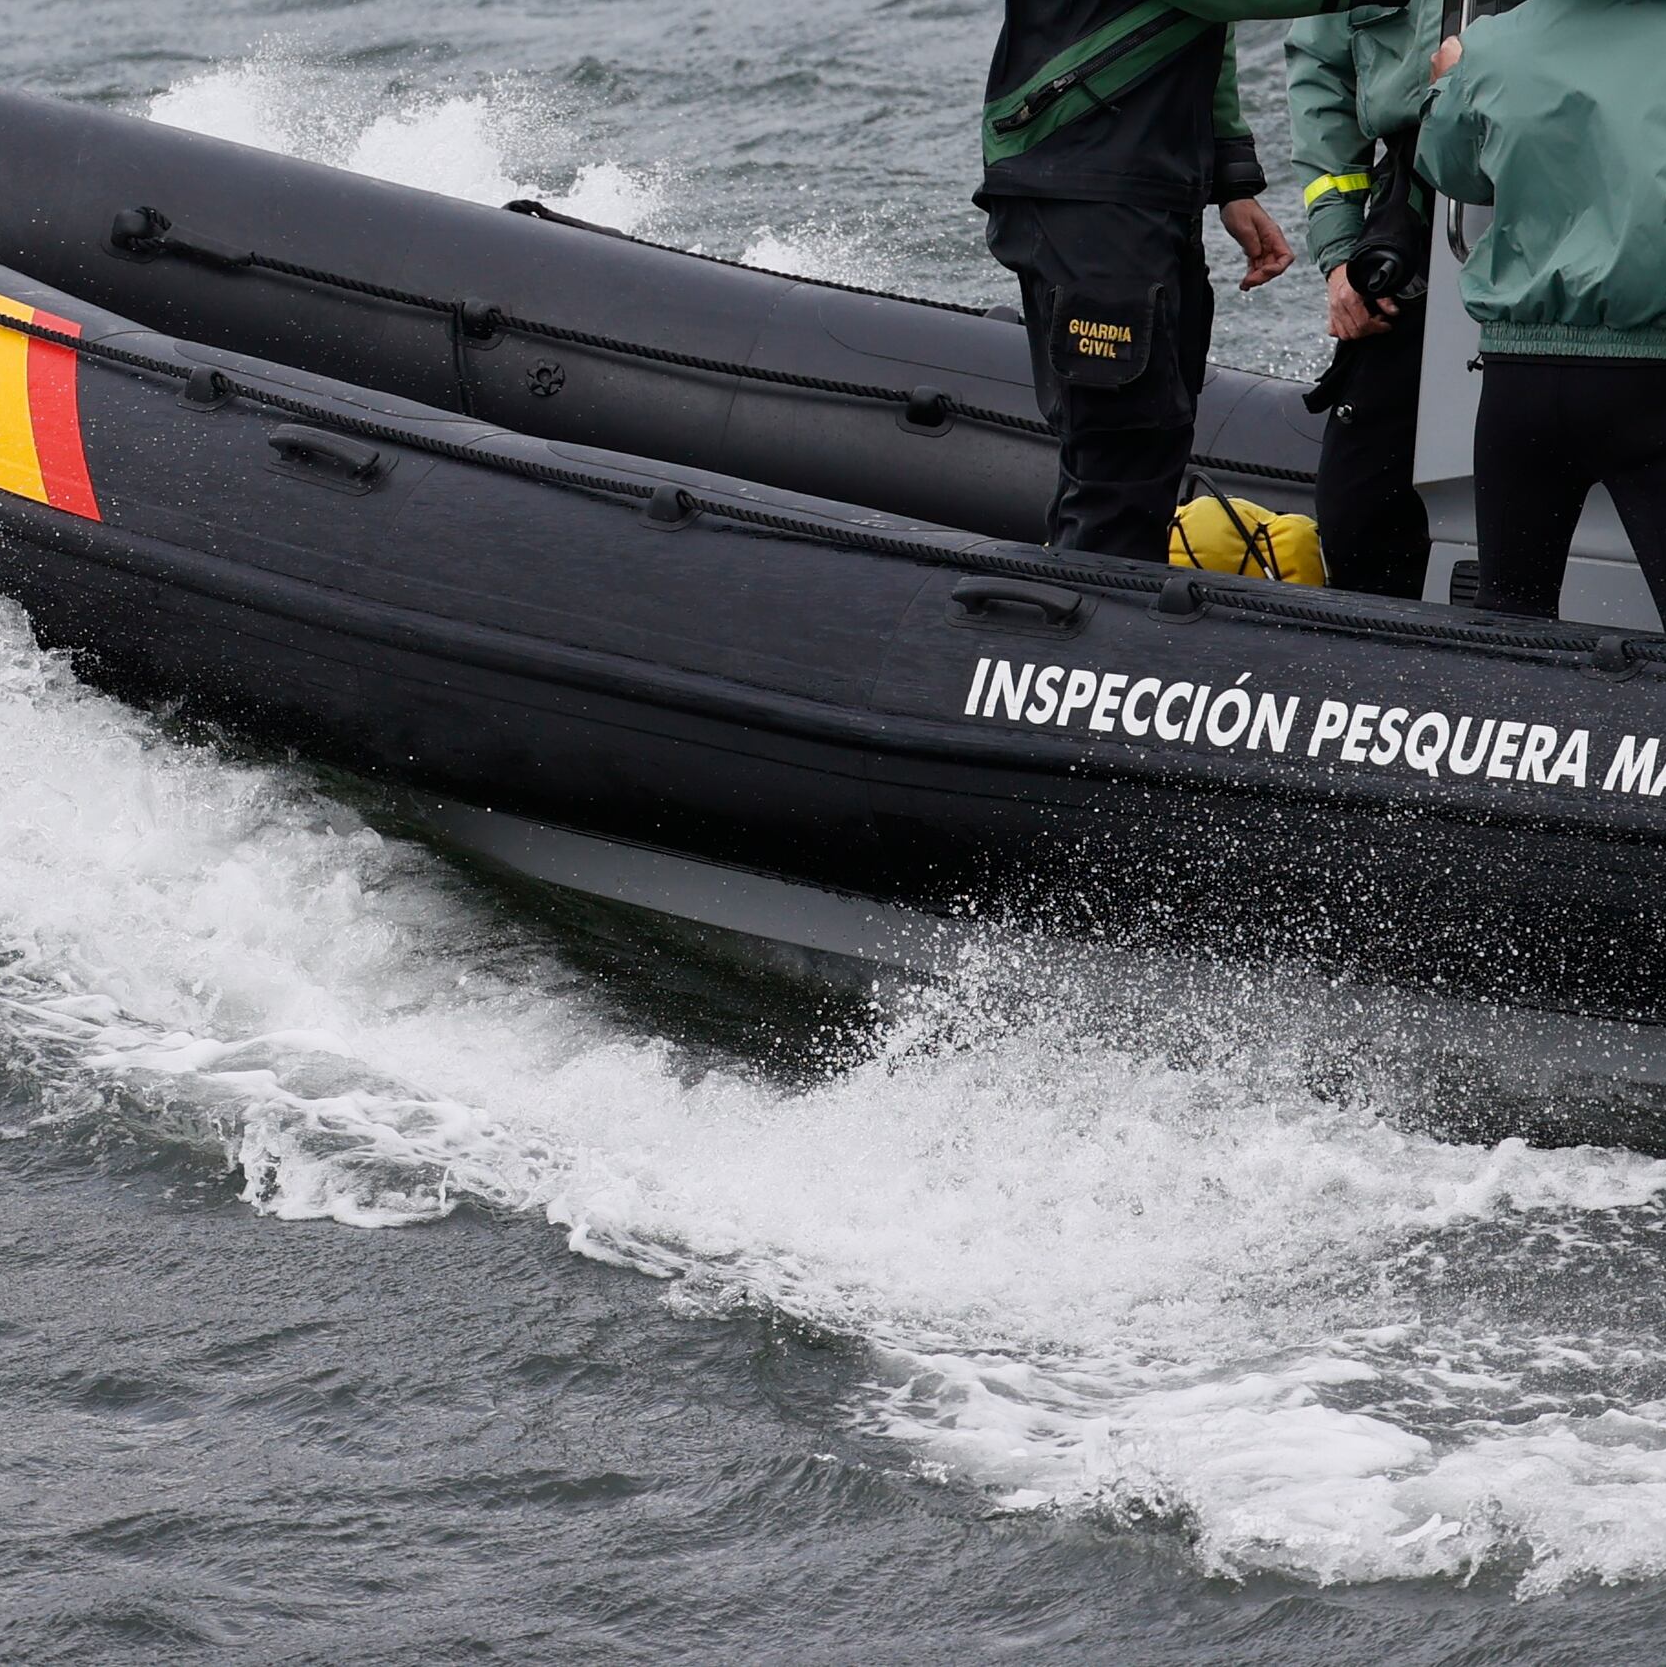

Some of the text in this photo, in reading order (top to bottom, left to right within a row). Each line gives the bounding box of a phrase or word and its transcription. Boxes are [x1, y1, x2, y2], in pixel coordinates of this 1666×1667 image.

[1068, 318, 1132, 343] GUARDIA
[1079, 338, 1116, 359] CIVIL
[963, 657, 1301, 754] INSPECCIÓN
[1306, 697, 1590, 788] PESQUERA
